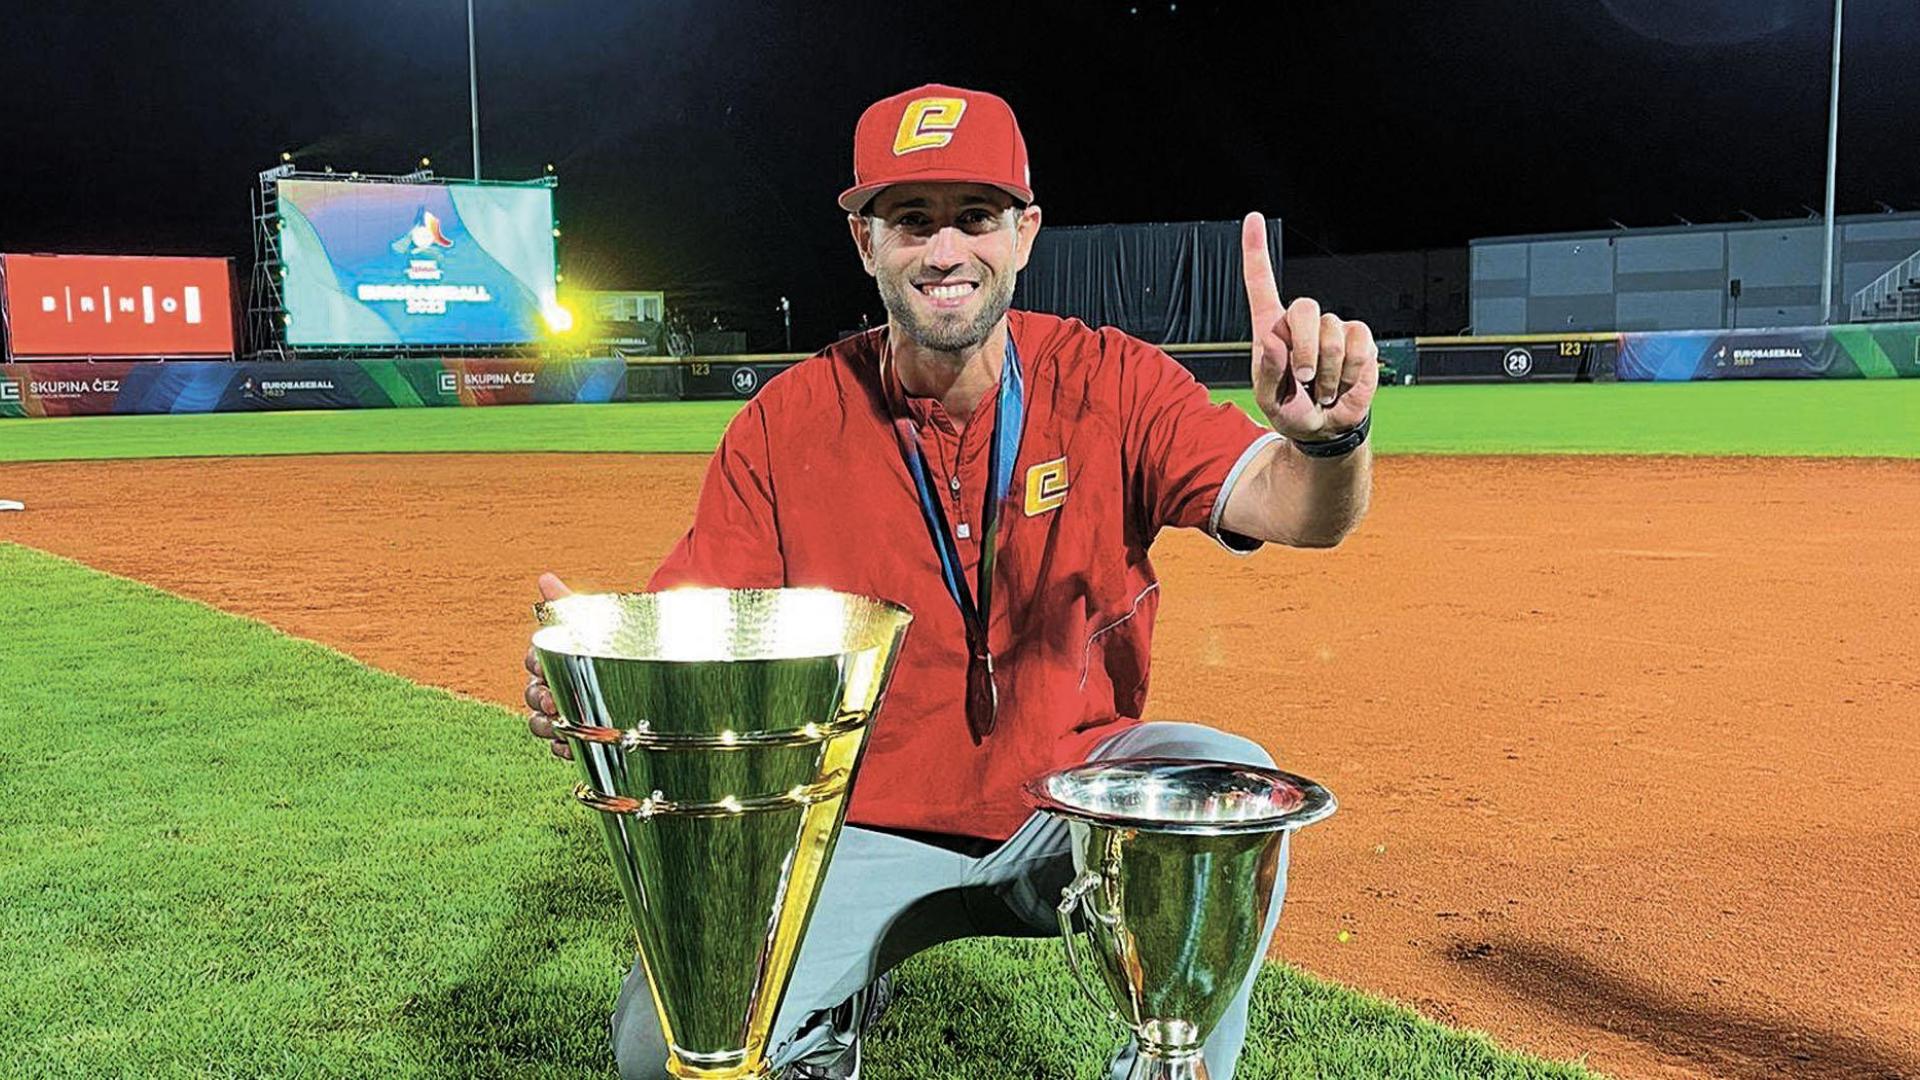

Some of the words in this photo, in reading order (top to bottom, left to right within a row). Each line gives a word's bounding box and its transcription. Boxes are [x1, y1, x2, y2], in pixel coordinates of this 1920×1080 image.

[1560, 342, 1581, 356] 123
[691, 363, 710, 376] 123
[1509, 355, 1527, 370] 29
[261, 381, 334, 389] EUROBASEBALL
[464, 374, 511, 385] SKUPINA
[513, 371, 536, 384] ČEZ
[736, 372, 753, 388] 34
[30, 380, 90, 394] SKUPINA
[92, 378, 119, 392] ČEZ
